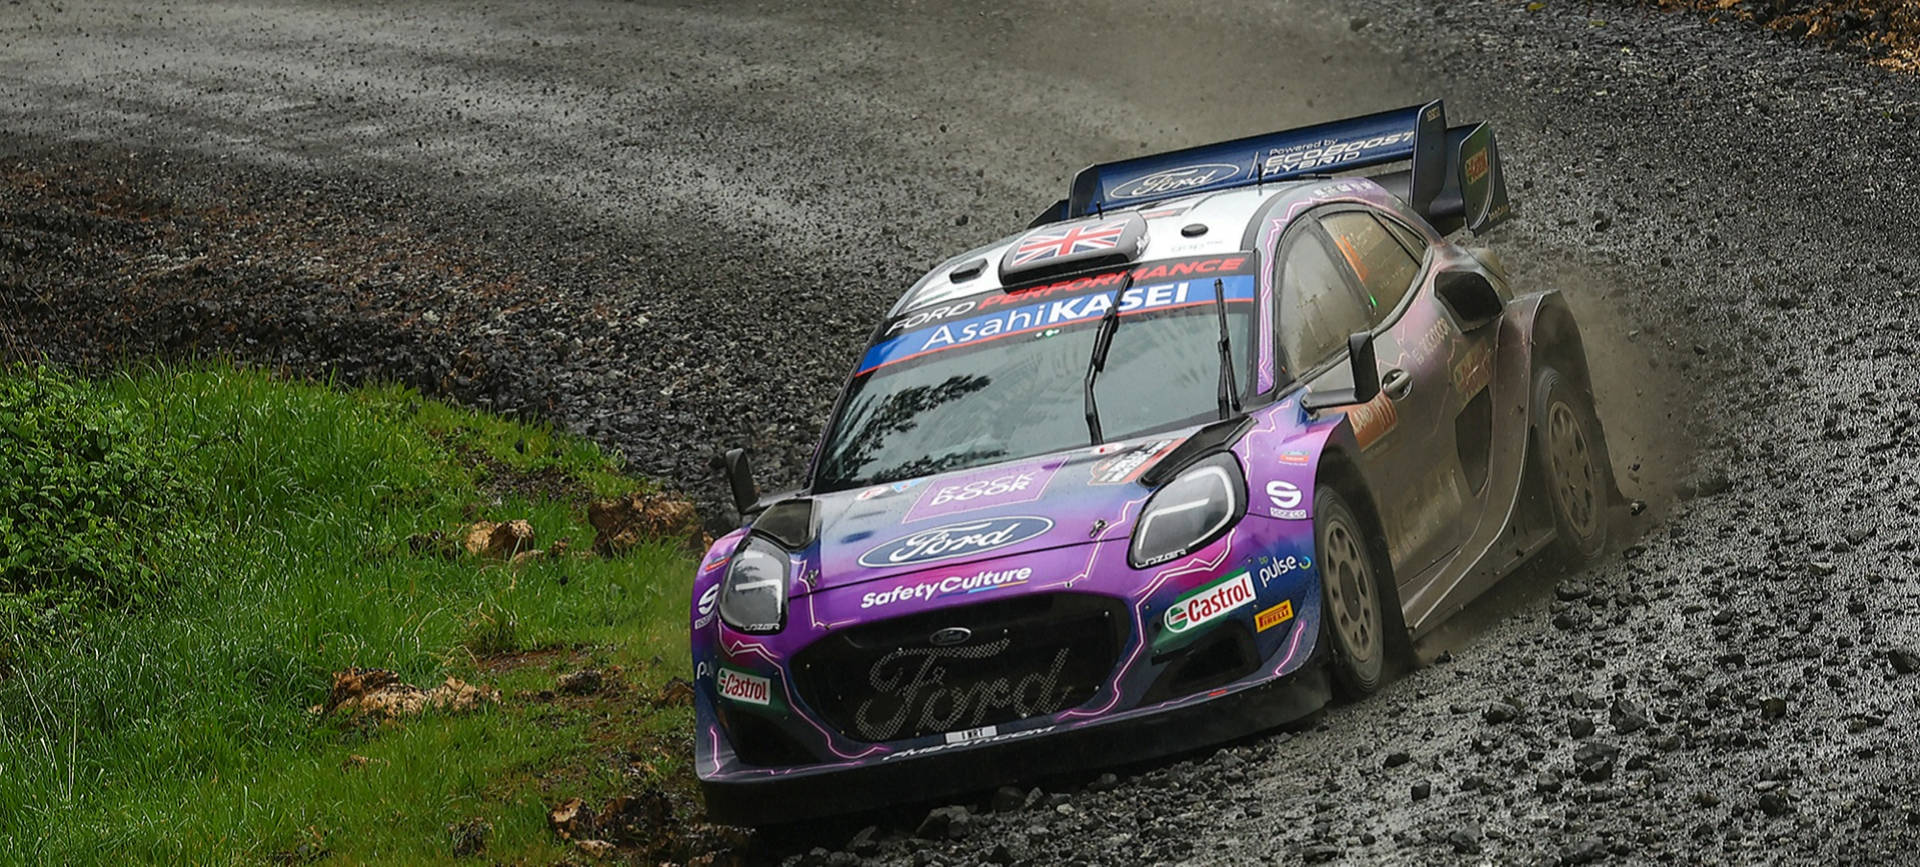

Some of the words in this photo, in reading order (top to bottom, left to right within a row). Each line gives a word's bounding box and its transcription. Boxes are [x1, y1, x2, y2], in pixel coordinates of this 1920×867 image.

[1269, 139, 1321, 156] Powered
[1323, 137, 1339, 148] by
[1261, 150, 1361, 177] HYBRID
[1131, 168, 1219, 197] Ford
[884, 300, 977, 337] FORD
[977, 257, 1246, 311] PERFORMANCE
[888, 521, 1022, 563] Ford
[861, 566, 1033, 609] SafetyCulture
[1259, 555, 1298, 588] pulse
[1188, 577, 1252, 623] Castrol
[1259, 604, 1290, 629] PIRELLI
[724, 673, 768, 701] Castrol
[853, 637, 1076, 743] Ford
